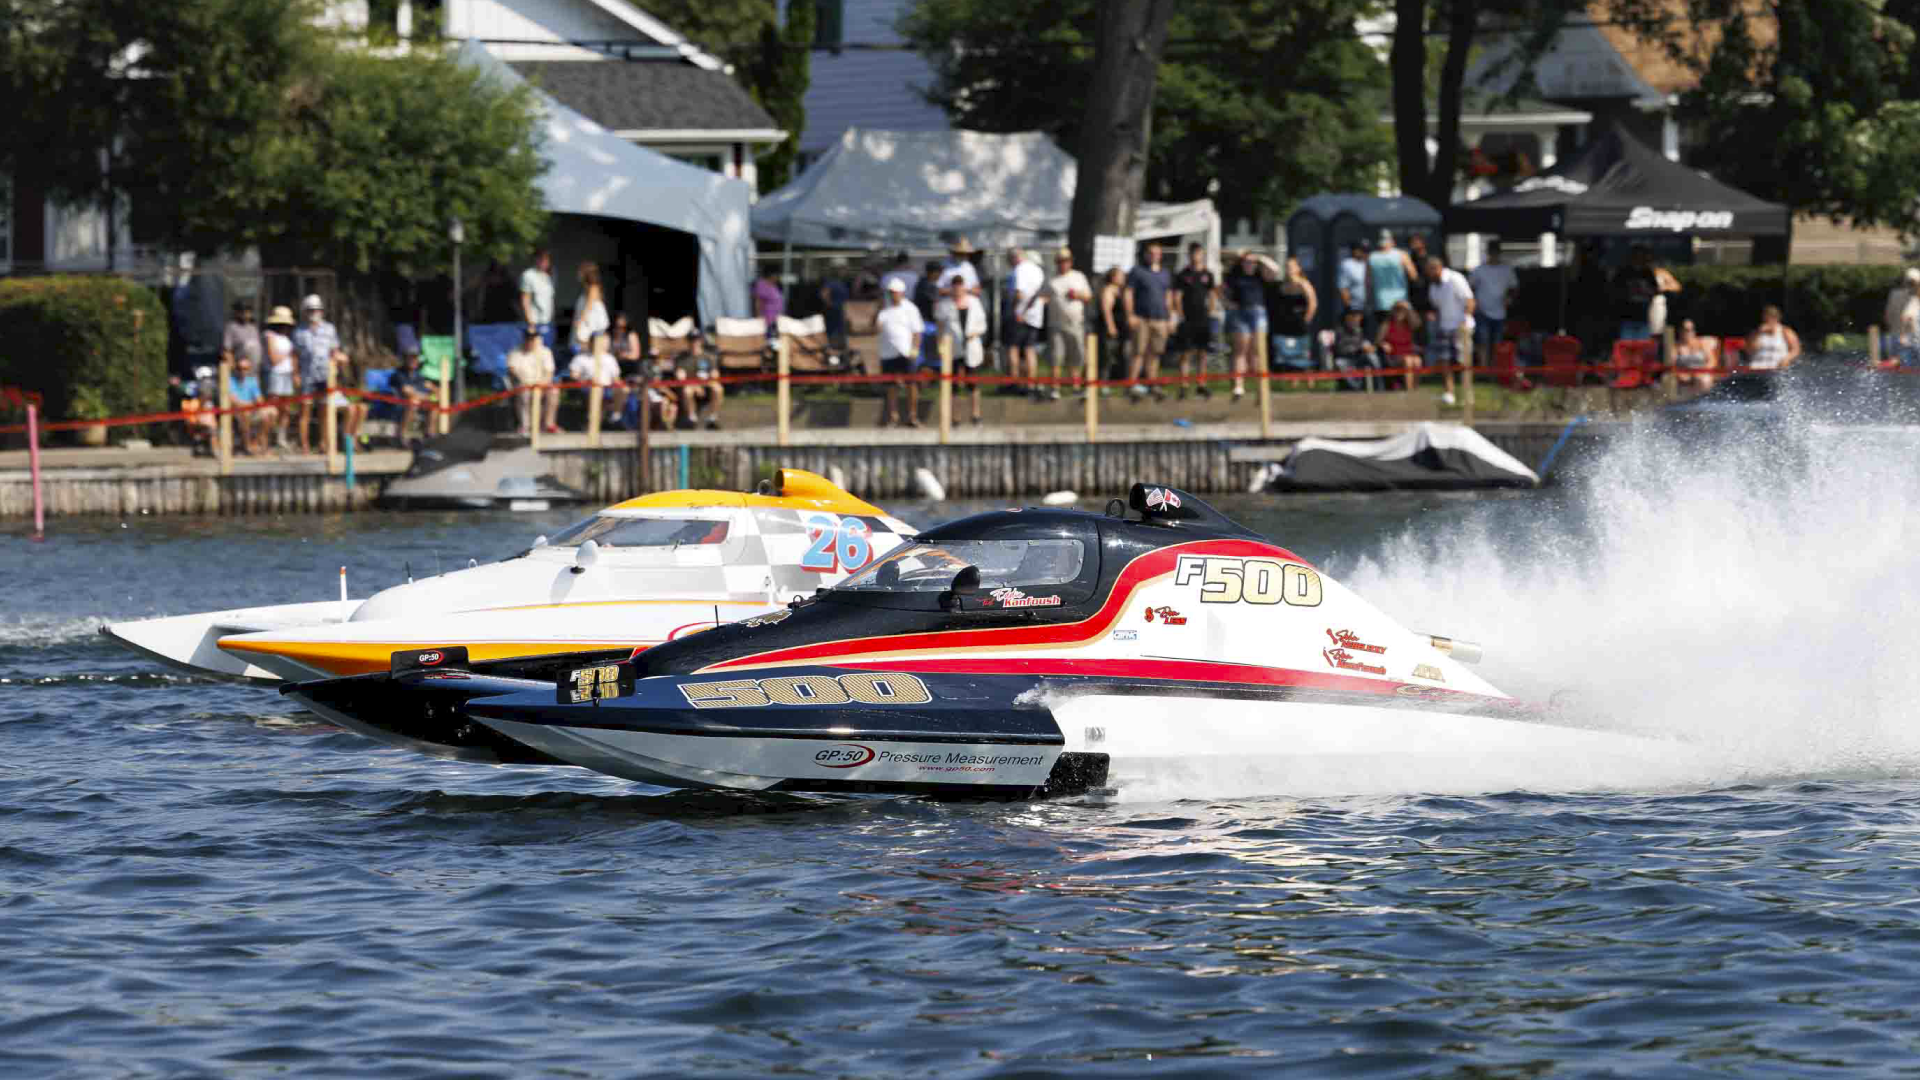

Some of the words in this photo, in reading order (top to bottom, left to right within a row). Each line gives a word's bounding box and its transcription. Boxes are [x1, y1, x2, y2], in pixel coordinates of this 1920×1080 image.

[801, 515, 873, 574] 26
[1175, 556, 1323, 607] F500
[1003, 595, 1062, 608] Kanfoush
[419, 653, 440, 662] GP:50
[677, 673, 932, 709] 500
[815, 749, 864, 762] GP:50
[878, 751, 941, 763] Pressure
[945, 752, 1044, 766] Measurement
